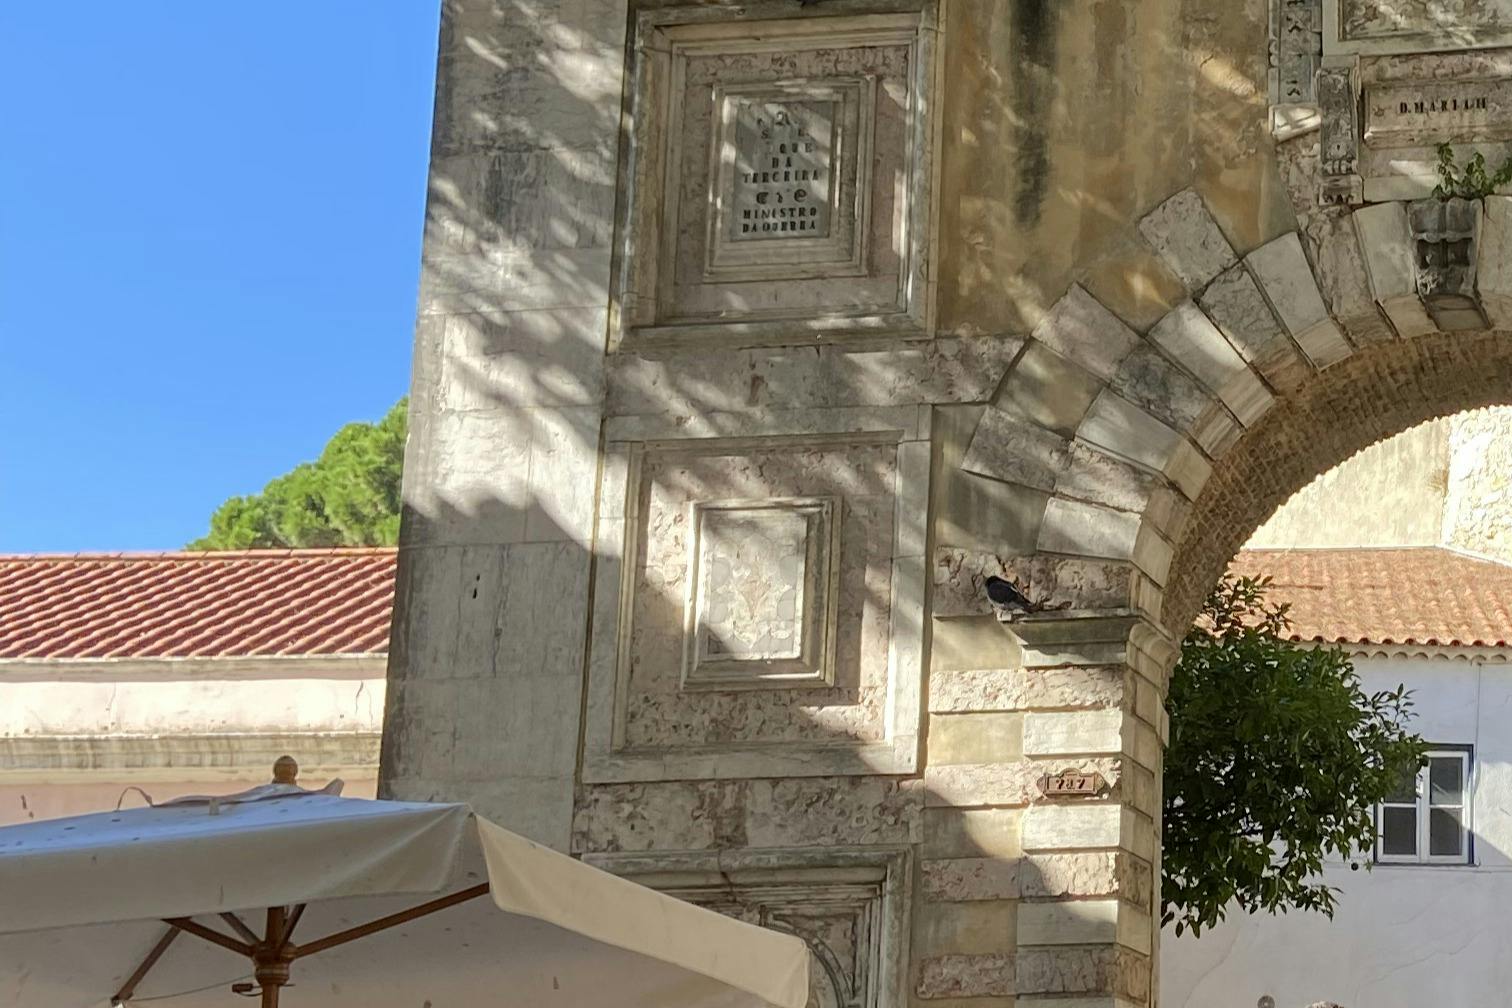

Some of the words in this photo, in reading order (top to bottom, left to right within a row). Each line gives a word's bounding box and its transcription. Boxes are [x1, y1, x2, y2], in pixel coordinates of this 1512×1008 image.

[771, 157, 793, 169] DA
[742, 170, 820, 184] TERCEIRA
[743, 207, 818, 219] MINISTRO
